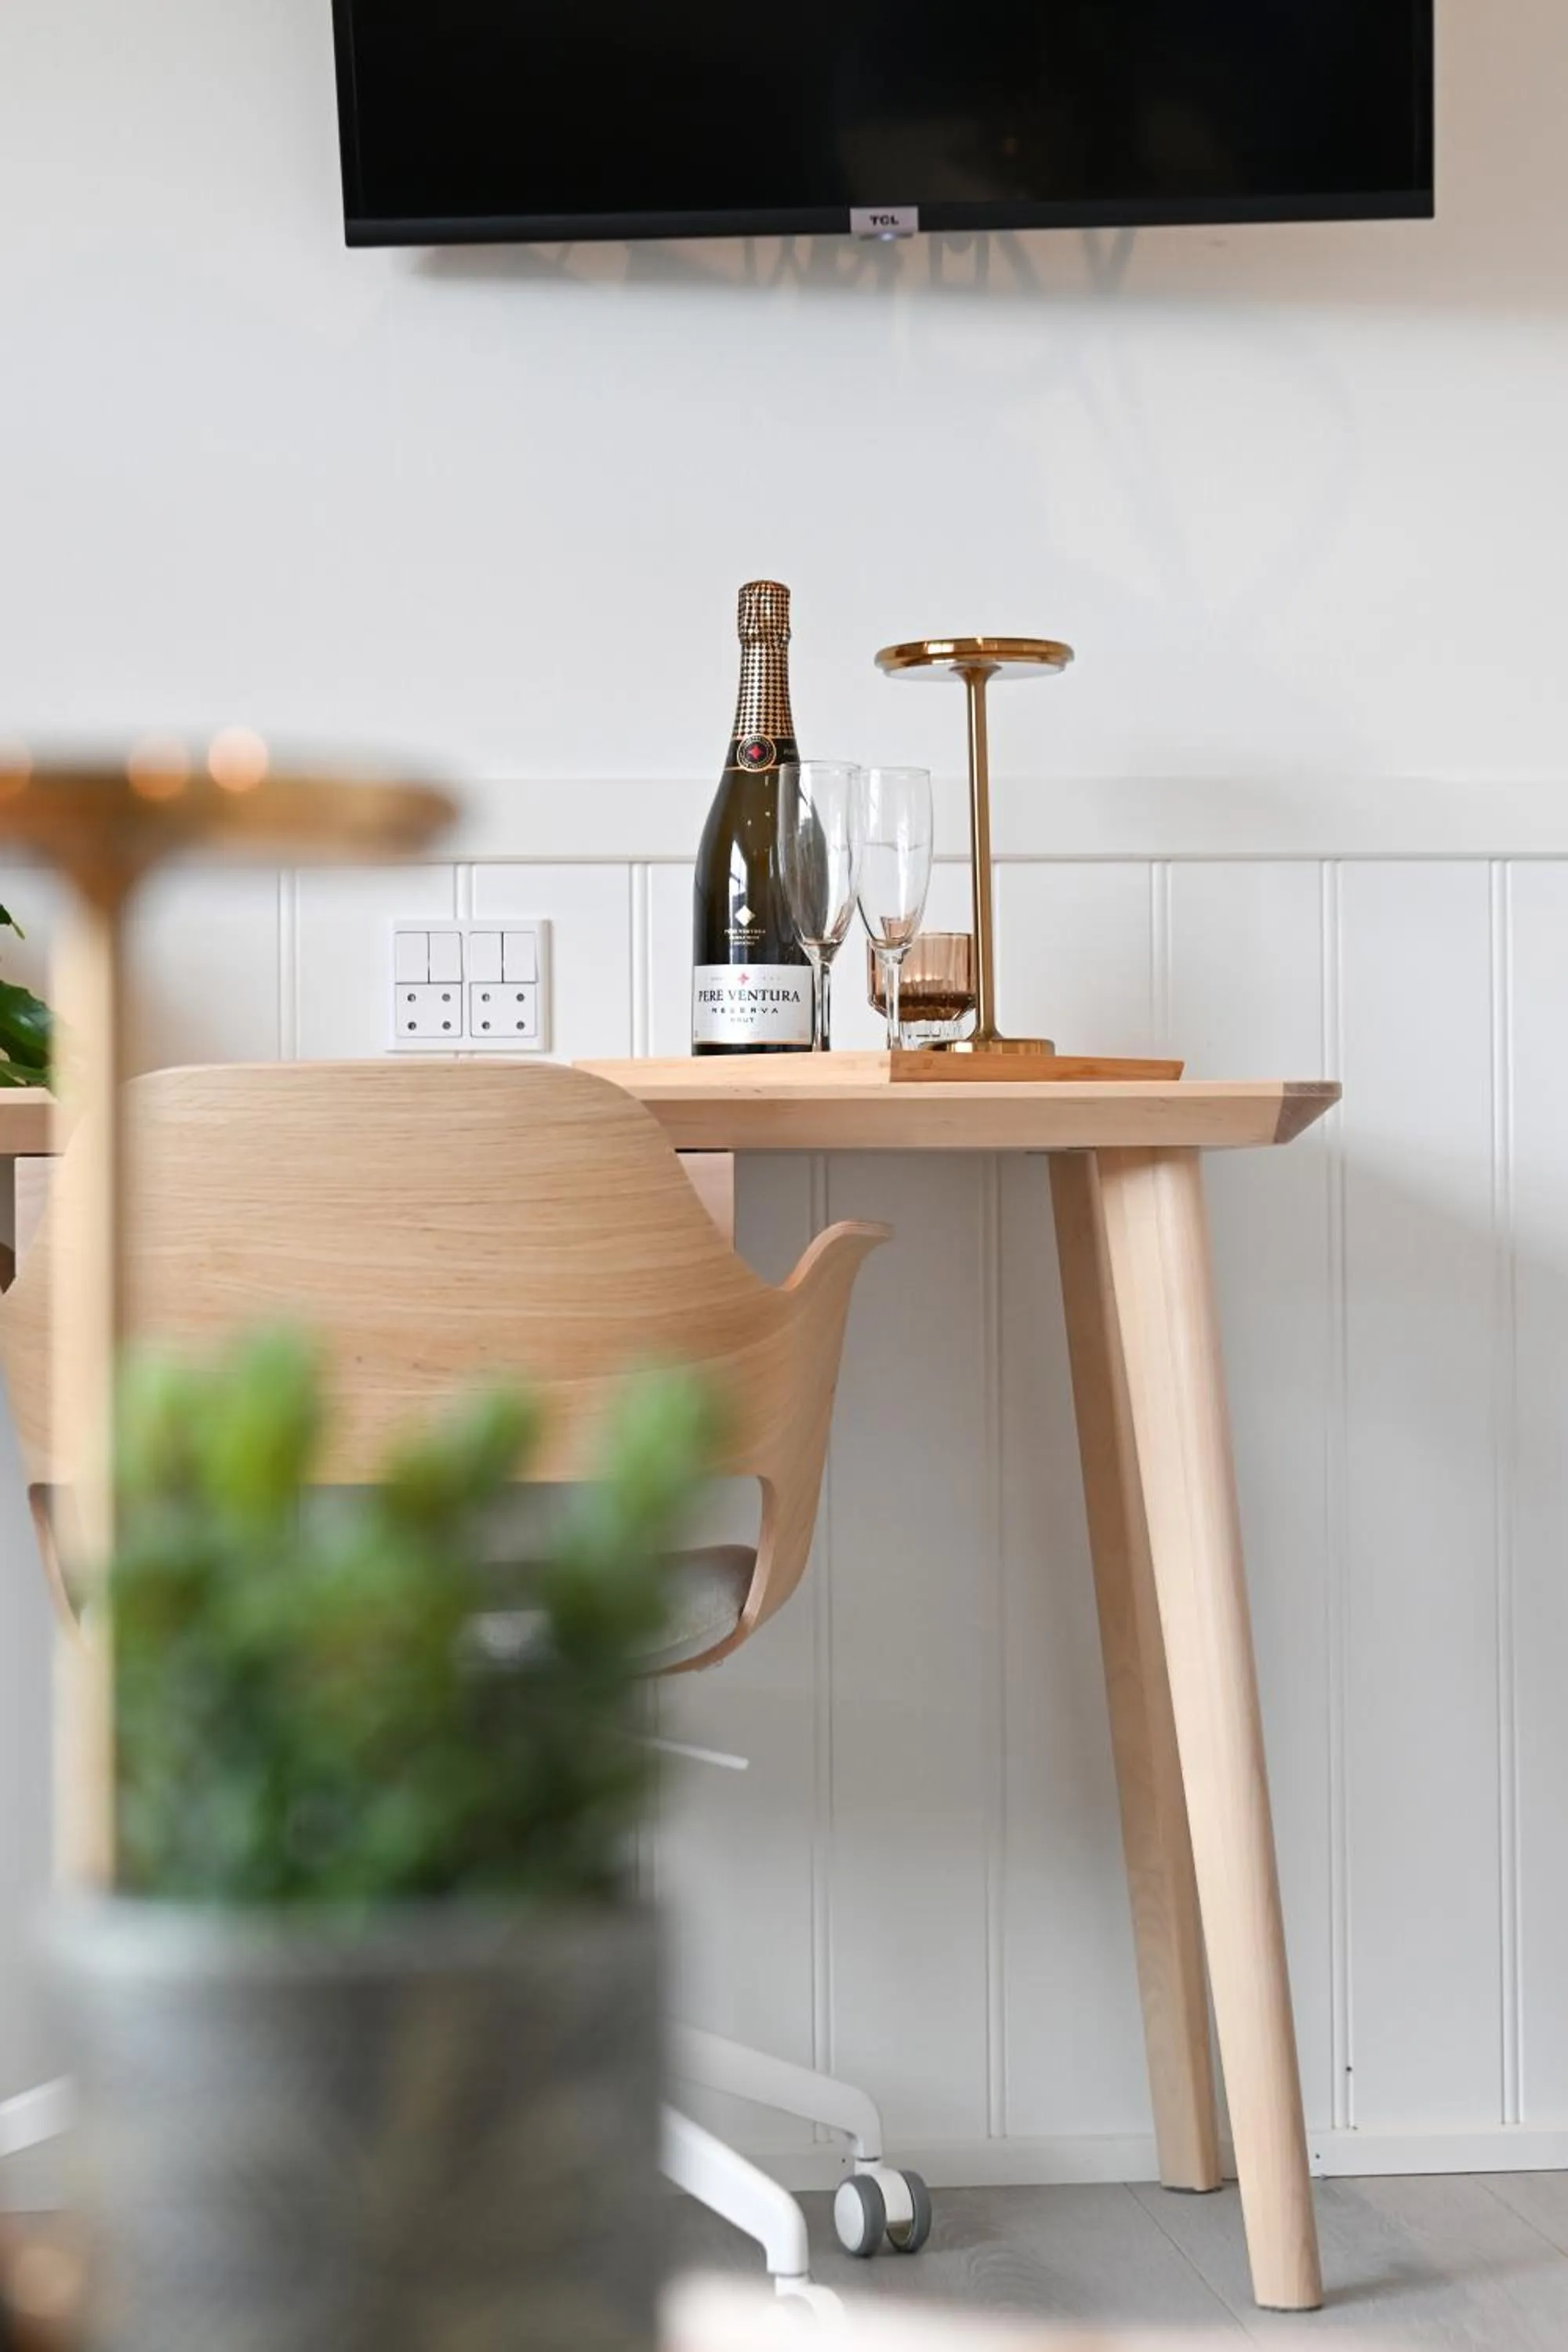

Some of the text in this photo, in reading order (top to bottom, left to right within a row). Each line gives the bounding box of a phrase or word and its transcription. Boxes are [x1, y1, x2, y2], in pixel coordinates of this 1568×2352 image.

[869, 214, 899, 226] TCL
[698, 988, 800, 1003] PERE VENTURA
